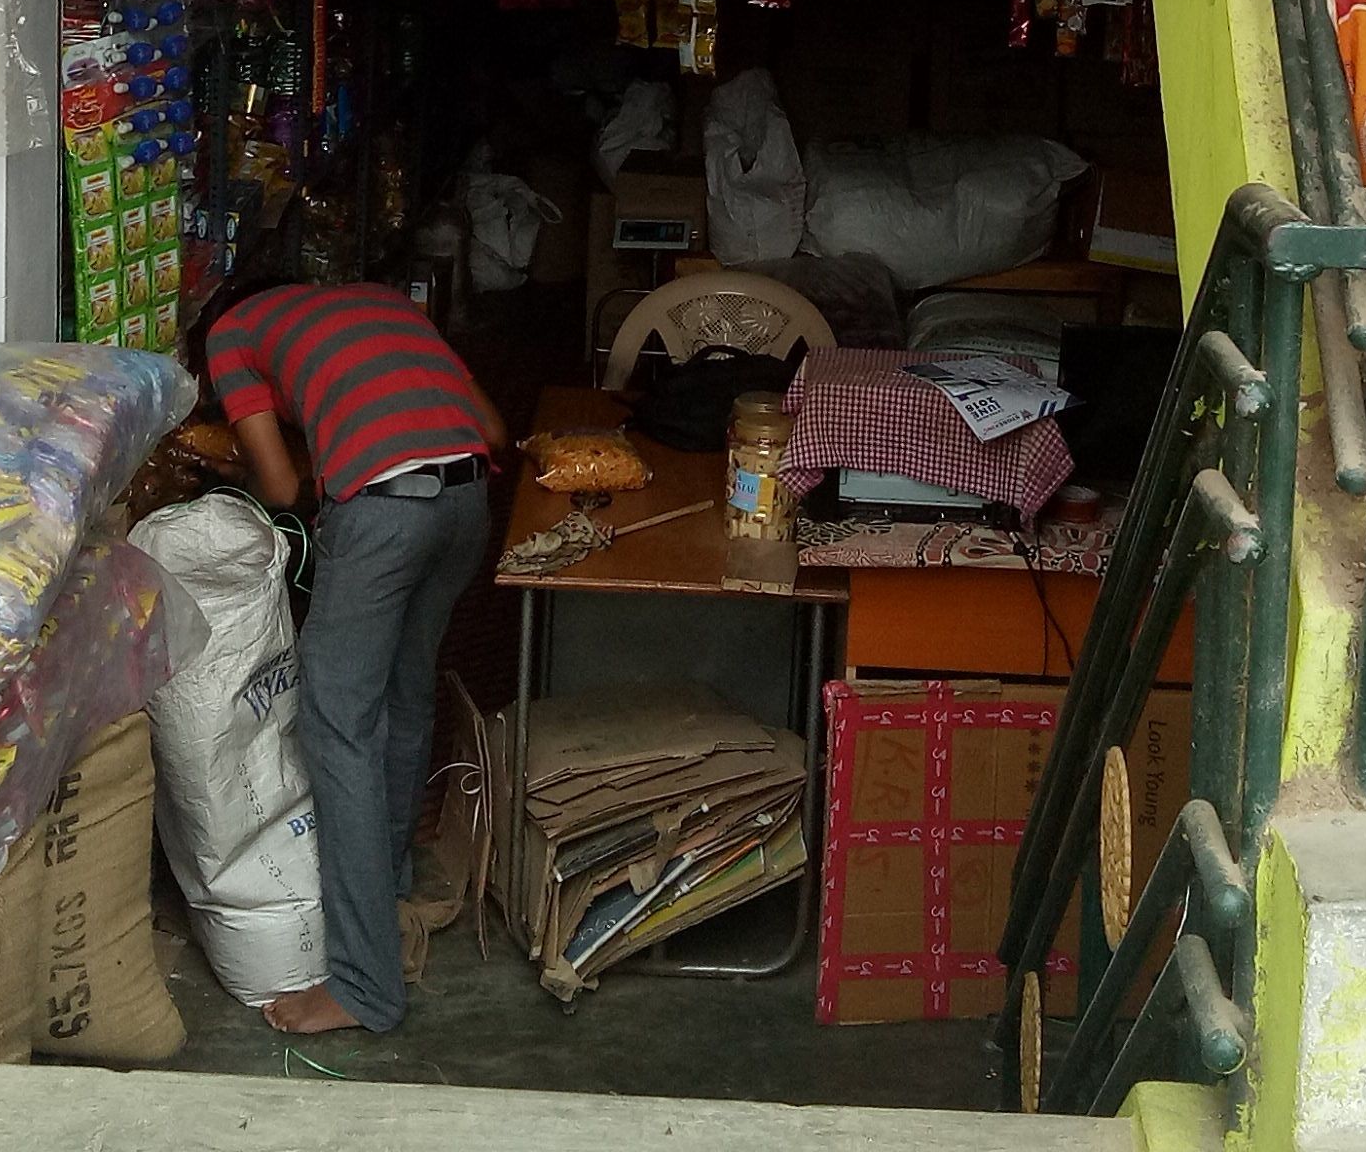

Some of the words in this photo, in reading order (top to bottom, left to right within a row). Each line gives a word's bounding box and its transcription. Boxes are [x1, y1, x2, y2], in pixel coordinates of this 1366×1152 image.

[965, 396, 995, 412] 2018
[970, 401, 1001, 419] JUNE
[1147, 719, 1169, 766] Look
[1138, 770, 1166, 829] Young
